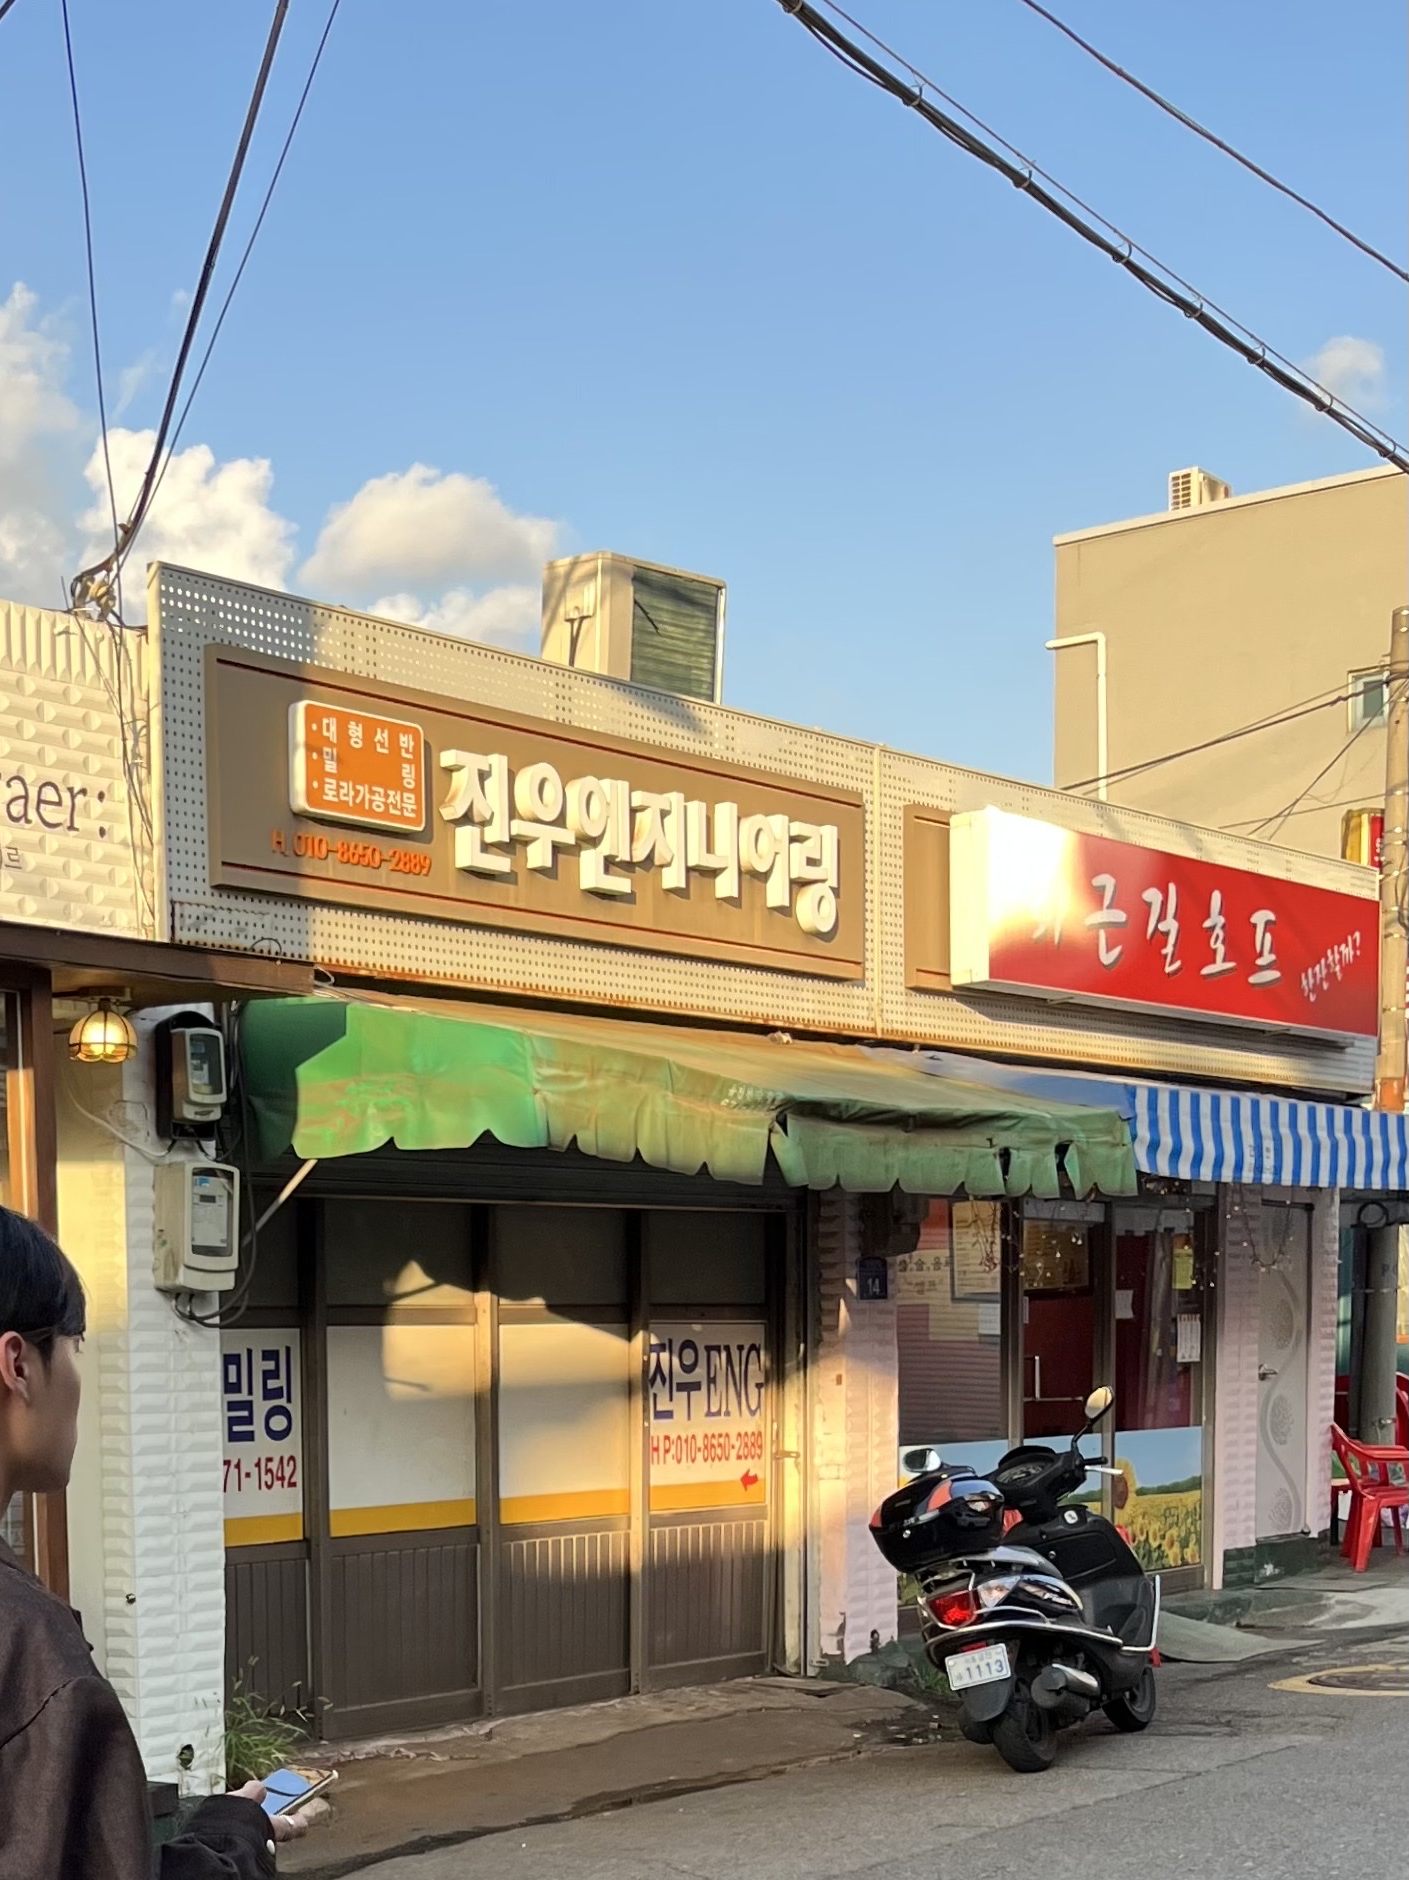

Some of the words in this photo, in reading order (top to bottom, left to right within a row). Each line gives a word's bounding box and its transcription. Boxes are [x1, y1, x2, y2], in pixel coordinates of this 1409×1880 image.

[322, 777, 418, 818] 로라가공전문
[293, 832, 432, 876] 010-8650-2889
[439, 748, 839, 934] 진우엔지니어링
[1033, 873, 1282, 985] 근길호프
[867, 1277, 880, 1296] 14
[223, 1346, 293, 1442] 밀링
[649, 1338, 765, 1421] 진우ENG
[223, 1455, 297, 1493] 71-1542
[966, 1658, 1004, 1681] 1113
